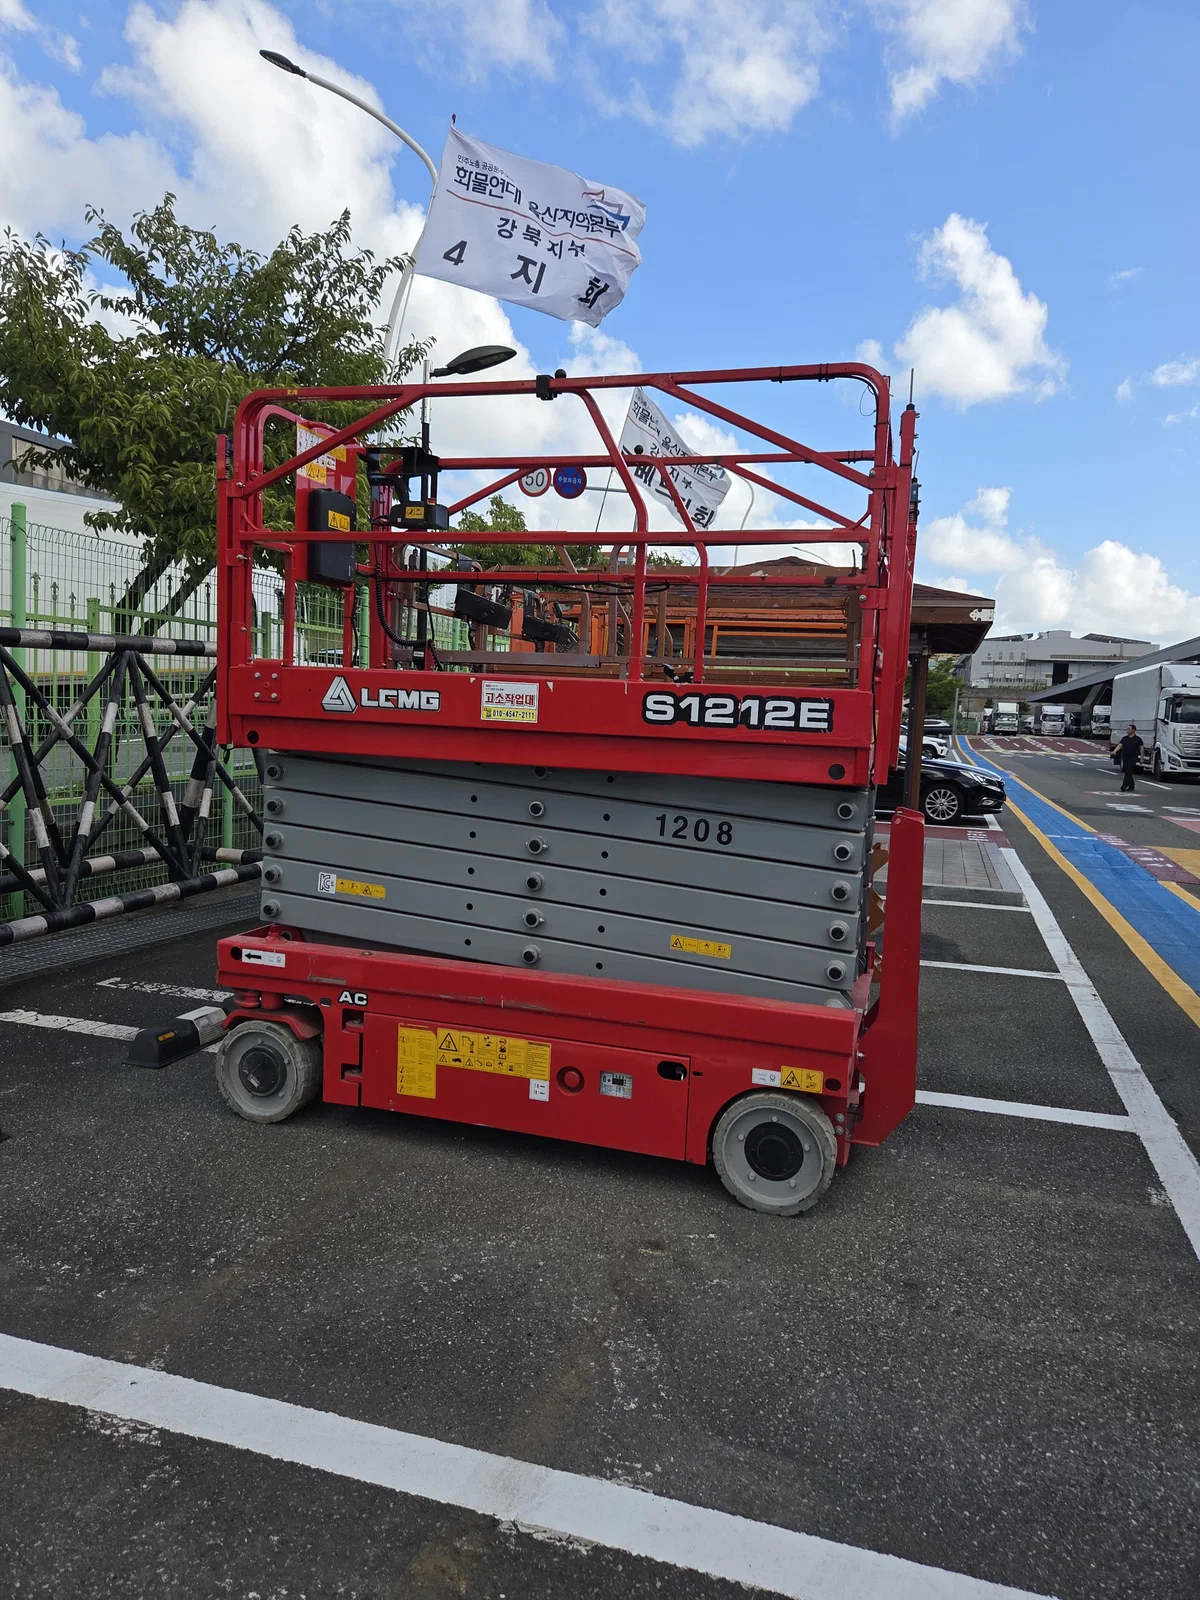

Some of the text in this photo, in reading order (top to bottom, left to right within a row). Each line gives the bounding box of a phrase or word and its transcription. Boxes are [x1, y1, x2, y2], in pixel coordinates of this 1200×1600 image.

[457, 154, 480, 169] 민주노총
[453, 165, 522, 206] 화물연대
[496, 217, 586, 260] 강북지부
[442, 240, 468, 266] 4
[525, 471, 545, 487] 50
[485, 692, 536, 707] 고소작업대
[492, 709, 535, 719] 010-4547-2111
[644, 694, 831, 730] S1212E
[655, 813, 733, 846] 1208
[338, 990, 368, 1006] AC
